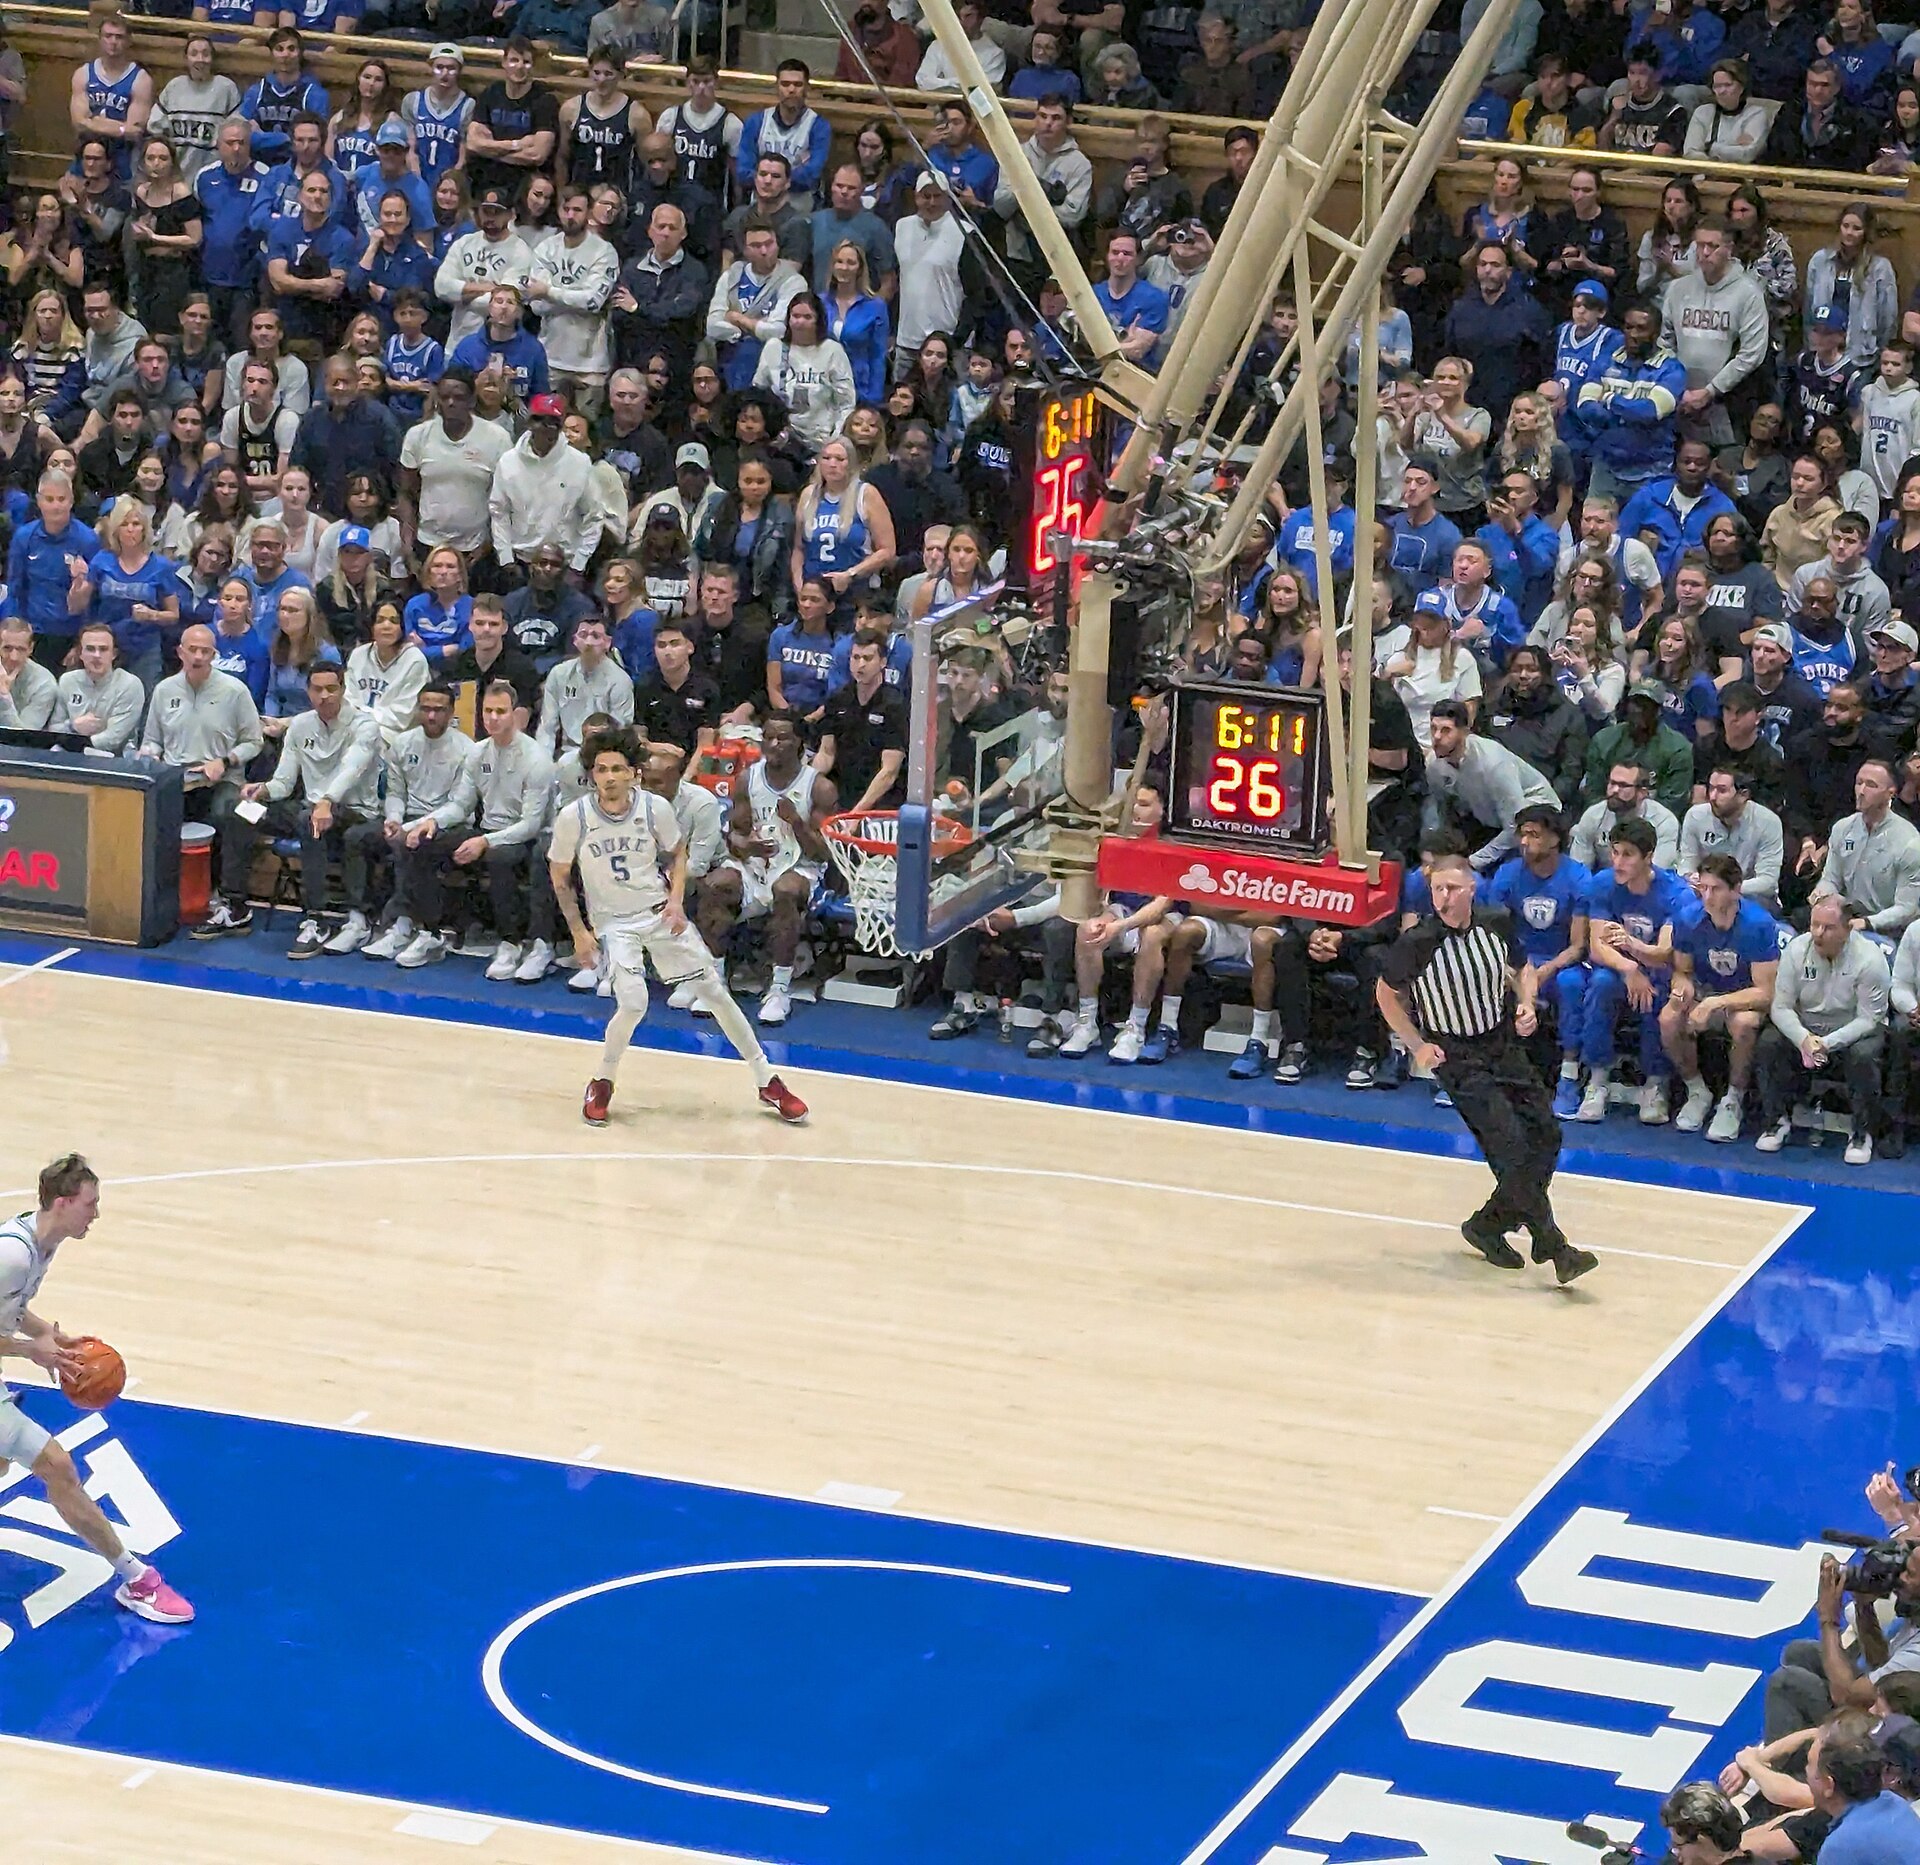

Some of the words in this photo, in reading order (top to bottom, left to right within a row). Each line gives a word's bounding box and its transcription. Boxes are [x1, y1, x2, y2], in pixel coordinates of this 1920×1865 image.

[416, 122, 458, 144] DUKE
[577, 125, 623, 145] Duke
[428, 140, 438, 166] 1
[674, 133, 718, 159] Duke
[594, 145, 603, 172] 1
[687, 159, 695, 182] 1
[463, 249, 506, 273] DUKE
[781, 367, 826, 386] Duke
[1874, 433, 1888, 454] 2
[818, 535, 836, 562] 2
[1706, 584, 1747, 609] UKE
[781, 647, 833, 668] DUKE
[1802, 662, 1849, 683] DUKE
[1217, 704, 1306, 757] 6:11
[1209, 756, 1282, 819] 26
[1191, 817, 1292, 839] DAKTRONICS
[587, 836, 648, 859] DUKE
[609, 855, 631, 883] 5
